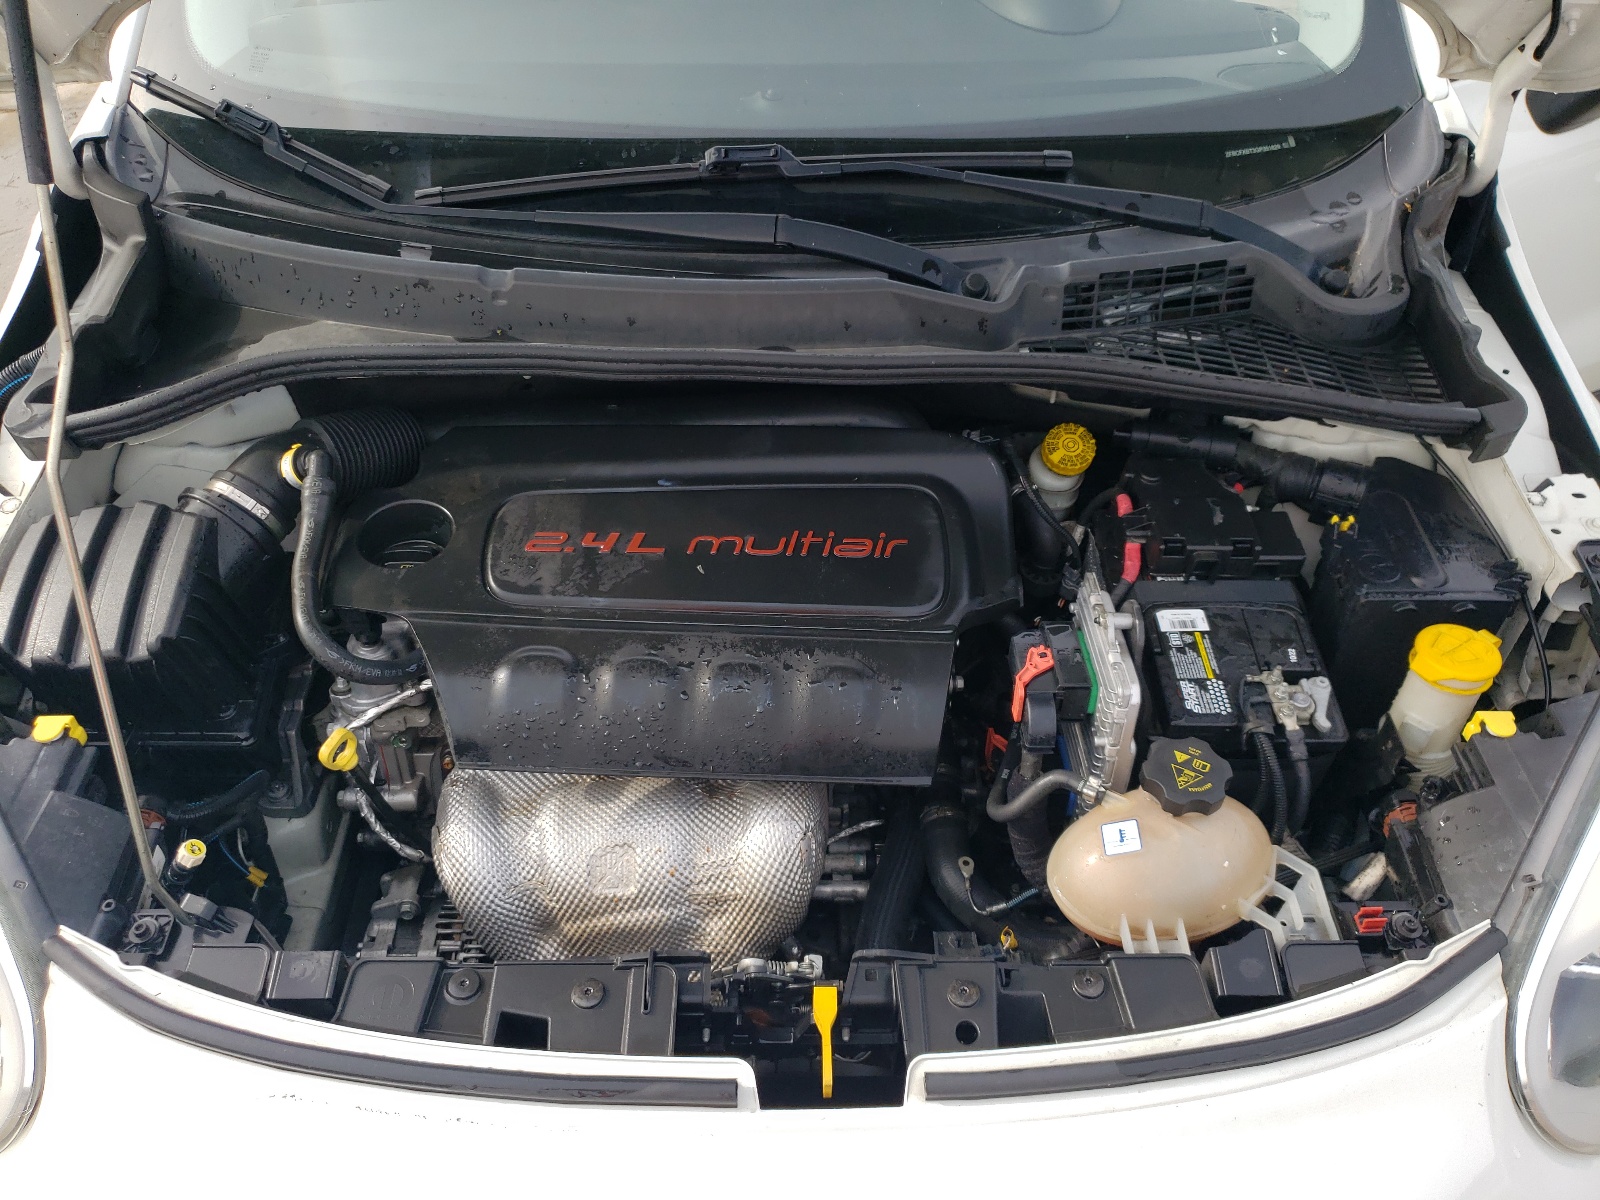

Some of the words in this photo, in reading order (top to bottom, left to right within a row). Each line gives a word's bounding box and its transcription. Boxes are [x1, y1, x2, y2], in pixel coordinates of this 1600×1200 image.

[686, 530, 909, 558] multiair
[1287, 648, 1298, 663] 1022
[1180, 680, 1193, 710] SUPER
